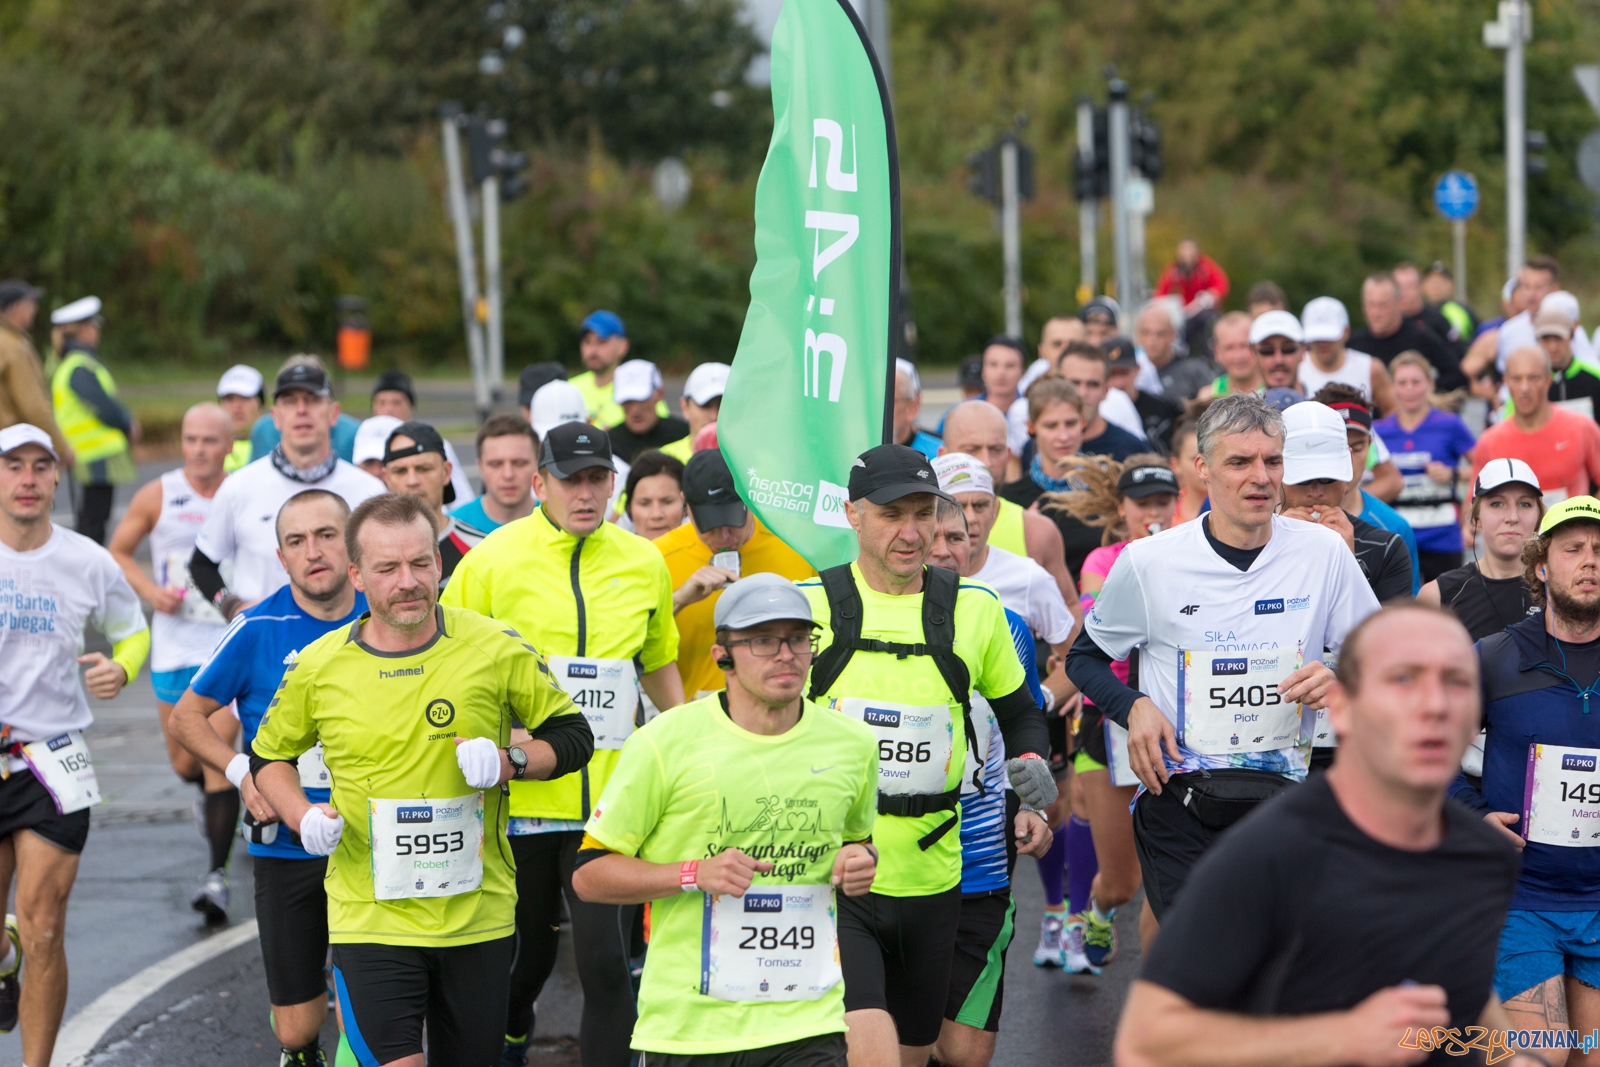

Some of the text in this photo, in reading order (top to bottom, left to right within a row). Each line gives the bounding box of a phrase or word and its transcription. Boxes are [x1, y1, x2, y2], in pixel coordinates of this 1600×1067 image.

[15, 593, 57, 613] Bartek
[1180, 605, 1200, 615] 4F
[9, 611, 55, 634] biegać
[1204, 630, 1236, 643] SIŁA
[379, 665, 424, 679] hummel
[572, 689, 615, 709] 4112
[1209, 684, 1281, 709] 5403
[432, 707, 449, 720] PZU
[584, 713, 605, 722] acek
[1234, 713, 1259, 723] Piotr
[428, 731, 458, 741] ZDROWIE
[878, 739, 931, 763] 686
[878, 767, 911, 779] Paweł
[1572, 808, 1600, 819] Marci
[396, 831, 464, 856] 5953
[413, 859, 450, 869] Robert
[739, 926, 815, 950] 2849
[756, 957, 802, 967] Tomasz
